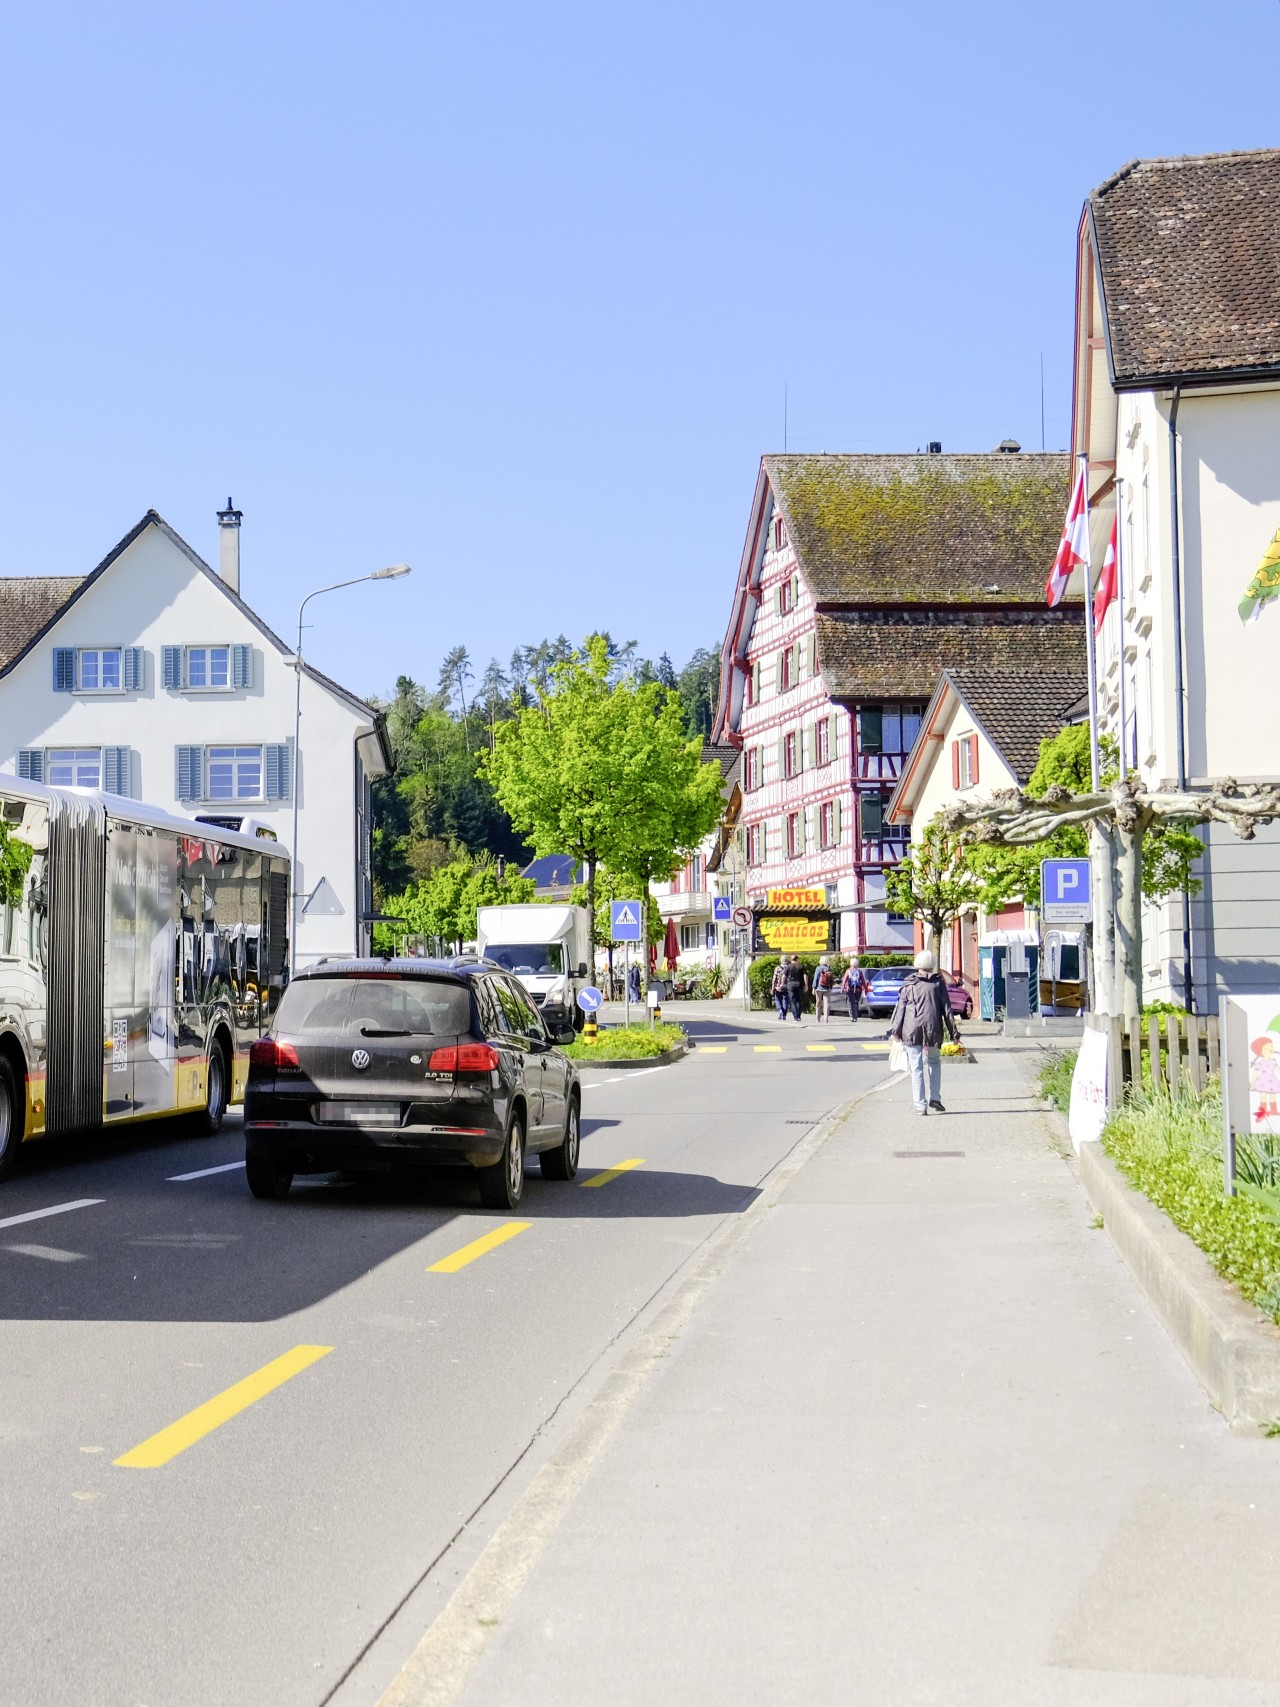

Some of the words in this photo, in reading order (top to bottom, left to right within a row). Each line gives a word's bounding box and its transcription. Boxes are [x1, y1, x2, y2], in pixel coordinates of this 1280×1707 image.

[1057, 868, 1079, 899] P
[773, 891, 821, 904] HOTEL
[773, 925, 824, 938] AMIGOS
